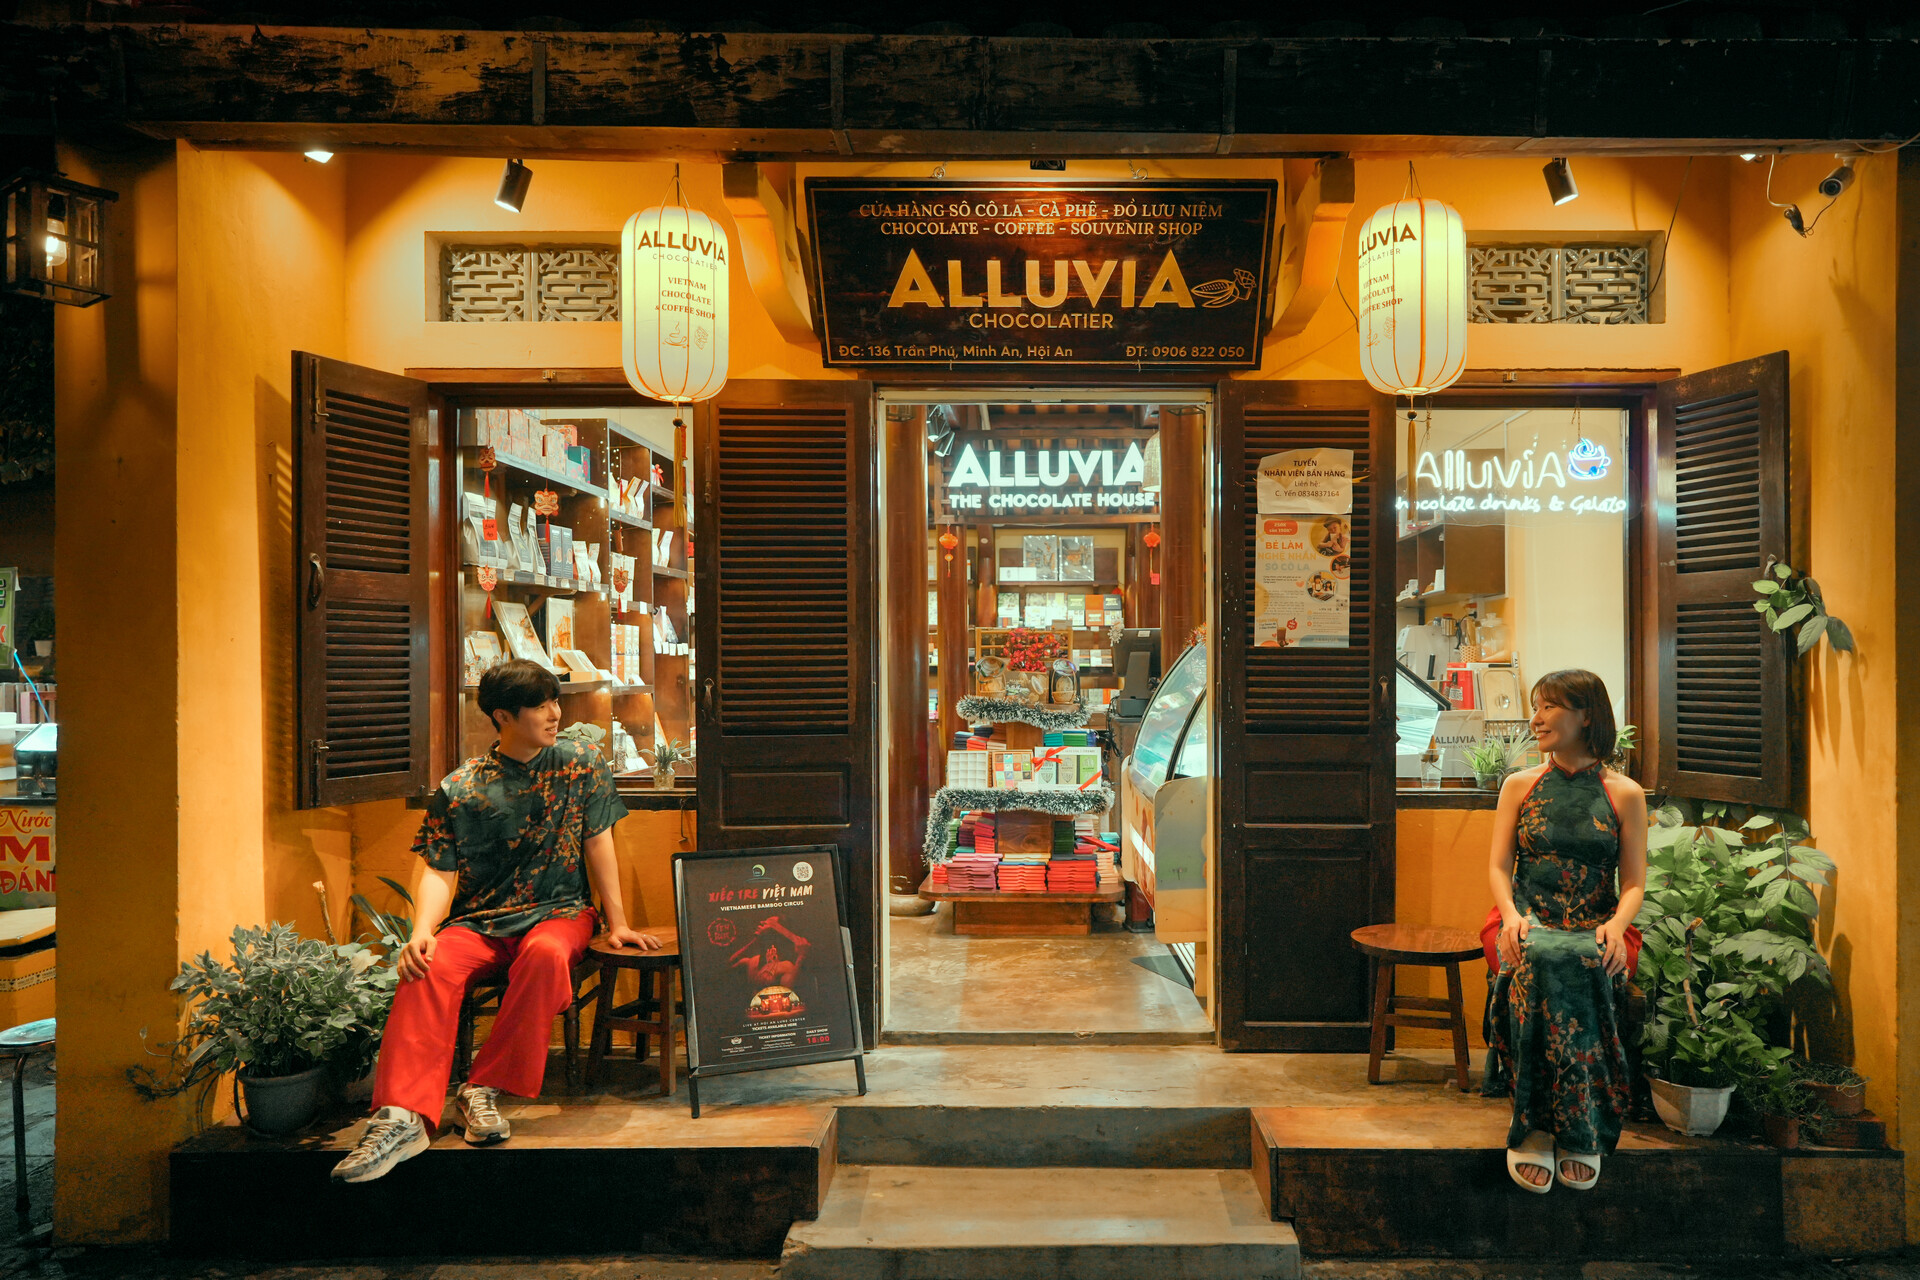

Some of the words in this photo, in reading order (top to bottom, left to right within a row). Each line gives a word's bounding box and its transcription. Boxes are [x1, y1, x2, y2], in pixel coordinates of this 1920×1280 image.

[898, 200, 945, 217] HÀNG
[949, 201, 971, 217] SÔ
[975, 201, 998, 217] CÔ
[1003, 204, 1023, 217] LA
[1039, 200, 1061, 217] CÀ
[1065, 200, 1098, 217] PHÊ
[1142, 203, 1175, 217] LƯU
[880, 222, 979, 235] CHOCOLATE
[994, 222, 1055, 235] COFFEE
[1070, 222, 1154, 235] SOUVENIR
[1158, 222, 1203, 235] SHOP
[637, 230, 726, 266] ALLUVIA
[652, 253, 718, 271] CHOCOLATIER
[668, 276, 707, 291] VIETNAM
[887, 248, 1196, 309] ALLUVIA
[661, 289, 712, 306] CHOCOLATE
[1381, 297, 1403, 309] SHOP
[661, 303, 695, 315] COFFEE
[695, 308, 716, 320] SHOP
[969, 313, 1114, 329] CHOCOLATIER
[839, 345, 865, 357] ĐC:
[868, 345, 891, 357] 136
[963, 345, 997, 357] Minh
[1000, 345, 1023, 359] An,
[1028, 345, 1050, 360] Hội
[1054, 345, 1073, 357] An
[1125, 345, 1148, 357] ĐT:
[1152, 346, 1187, 358] 0906
[1191, 346, 1215, 358] 822
[1218, 346, 1245, 358] 050
[948, 441, 1145, 487] ALLUVIA
[1287, 469, 1305, 477] VIÊN
[1323, 469, 1346, 477] HÀNG
[949, 494, 982, 509] THE
[988, 493, 1092, 508] CHOCOLATE
[1097, 492, 1155, 507] HOUSE
[1480, 493, 1542, 513] drinks
[1435, 735, 1477, 744] ALLUVIA
[0, 809, 53, 834] Nước
[737, 888, 759, 900] TRE
[790, 884, 813, 897] NAM
[720, 903, 757, 912] VIETNAMESE
[757, 901, 783, 909] BAMBOO
